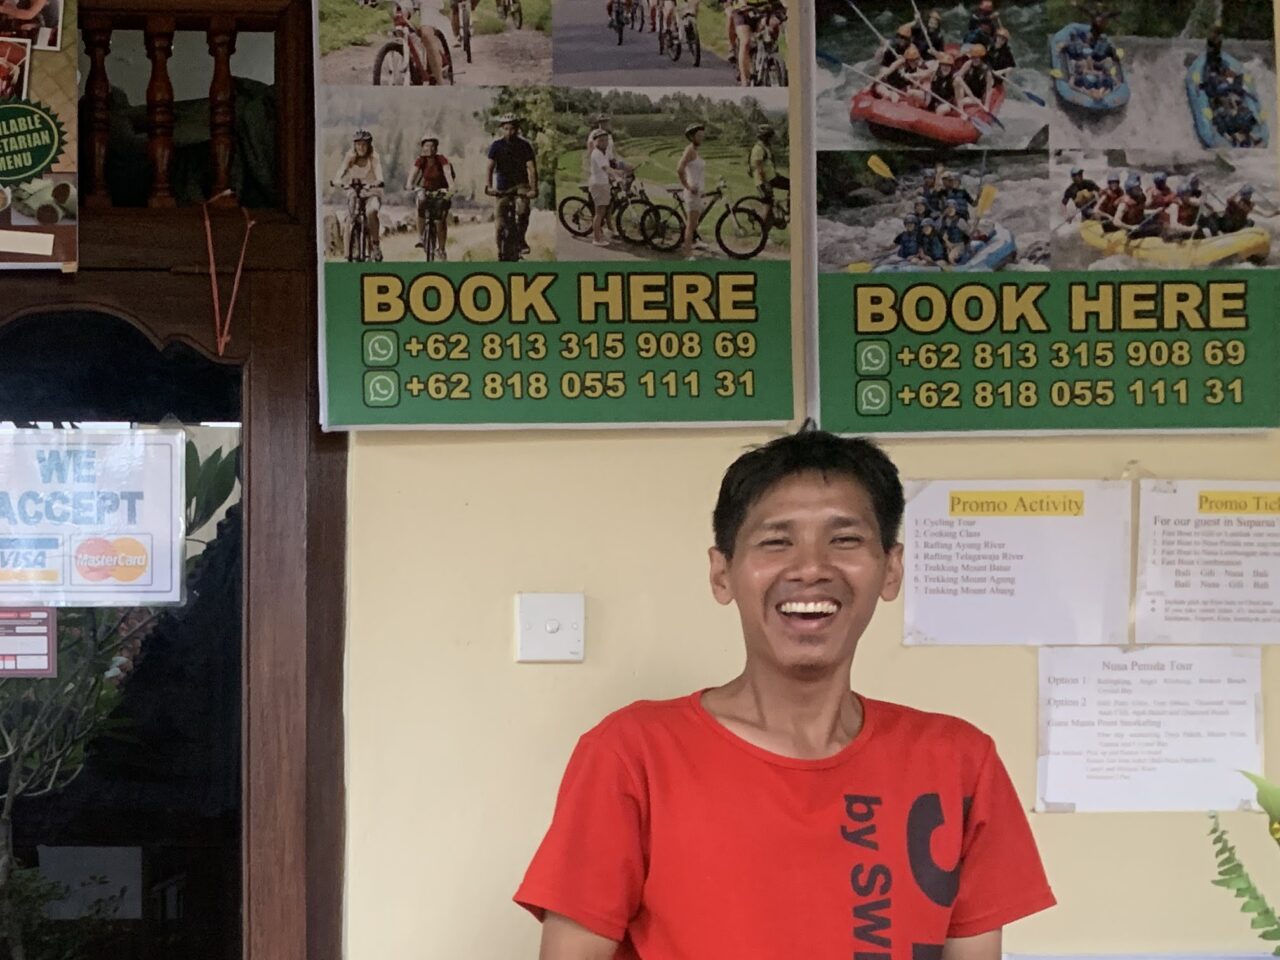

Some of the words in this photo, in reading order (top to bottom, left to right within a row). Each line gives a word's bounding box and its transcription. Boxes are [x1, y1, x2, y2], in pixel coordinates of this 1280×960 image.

[360, 272, 560, 325] BOOK
[577, 271, 759, 324] HERE
[854, 283, 1050, 336] BOOK
[1069, 280, 1248, 332] HERE
[404, 332, 471, 361] +62
[482, 332, 548, 361] 813
[560, 331, 626, 360] 315
[636, 331, 702, 360] 908
[713, 330, 758, 360] 69
[896, 342, 962, 371] +62
[973, 341, 1039, 370] 813
[1050, 341, 1115, 369] 315
[1127, 340, 1192, 368] 908
[1203, 339, 1247, 367] 69
[404, 371, 472, 401] +62
[483, 371, 550, 400] 818
[561, 370, 627, 400] 055
[639, 370, 701, 399] 111
[715, 369, 755, 399] 31
[896, 380, 962, 410] +62
[973, 380, 1039, 409] 818
[1050, 379, 1115, 408] 055
[1128, 379, 1189, 406] 111
[1204, 378, 1245, 405] 31
[36, 449, 97, 484] WE
[950, 496, 1008, 513] Promo
[1014, 495, 1084, 516] Activity
[1199, 495, 1248, 511] Promo
[923, 518, 955, 528] Cycling
[1154, 516, 1170, 526] For
[1174, 518, 1191, 526] our
[923, 530, 957, 539] Cooking
[923, 541, 953, 551] Rafting
[984, 541, 1006, 549] River
[0, 550, 47, 569] VISA
[76, 553, 146, 567] MasterCard
[923, 552, 952, 561] Rafting
[1002, 553, 1024, 561] River
[1170, 661, 1193, 671] Tour
[840, 793, 882, 852] by
